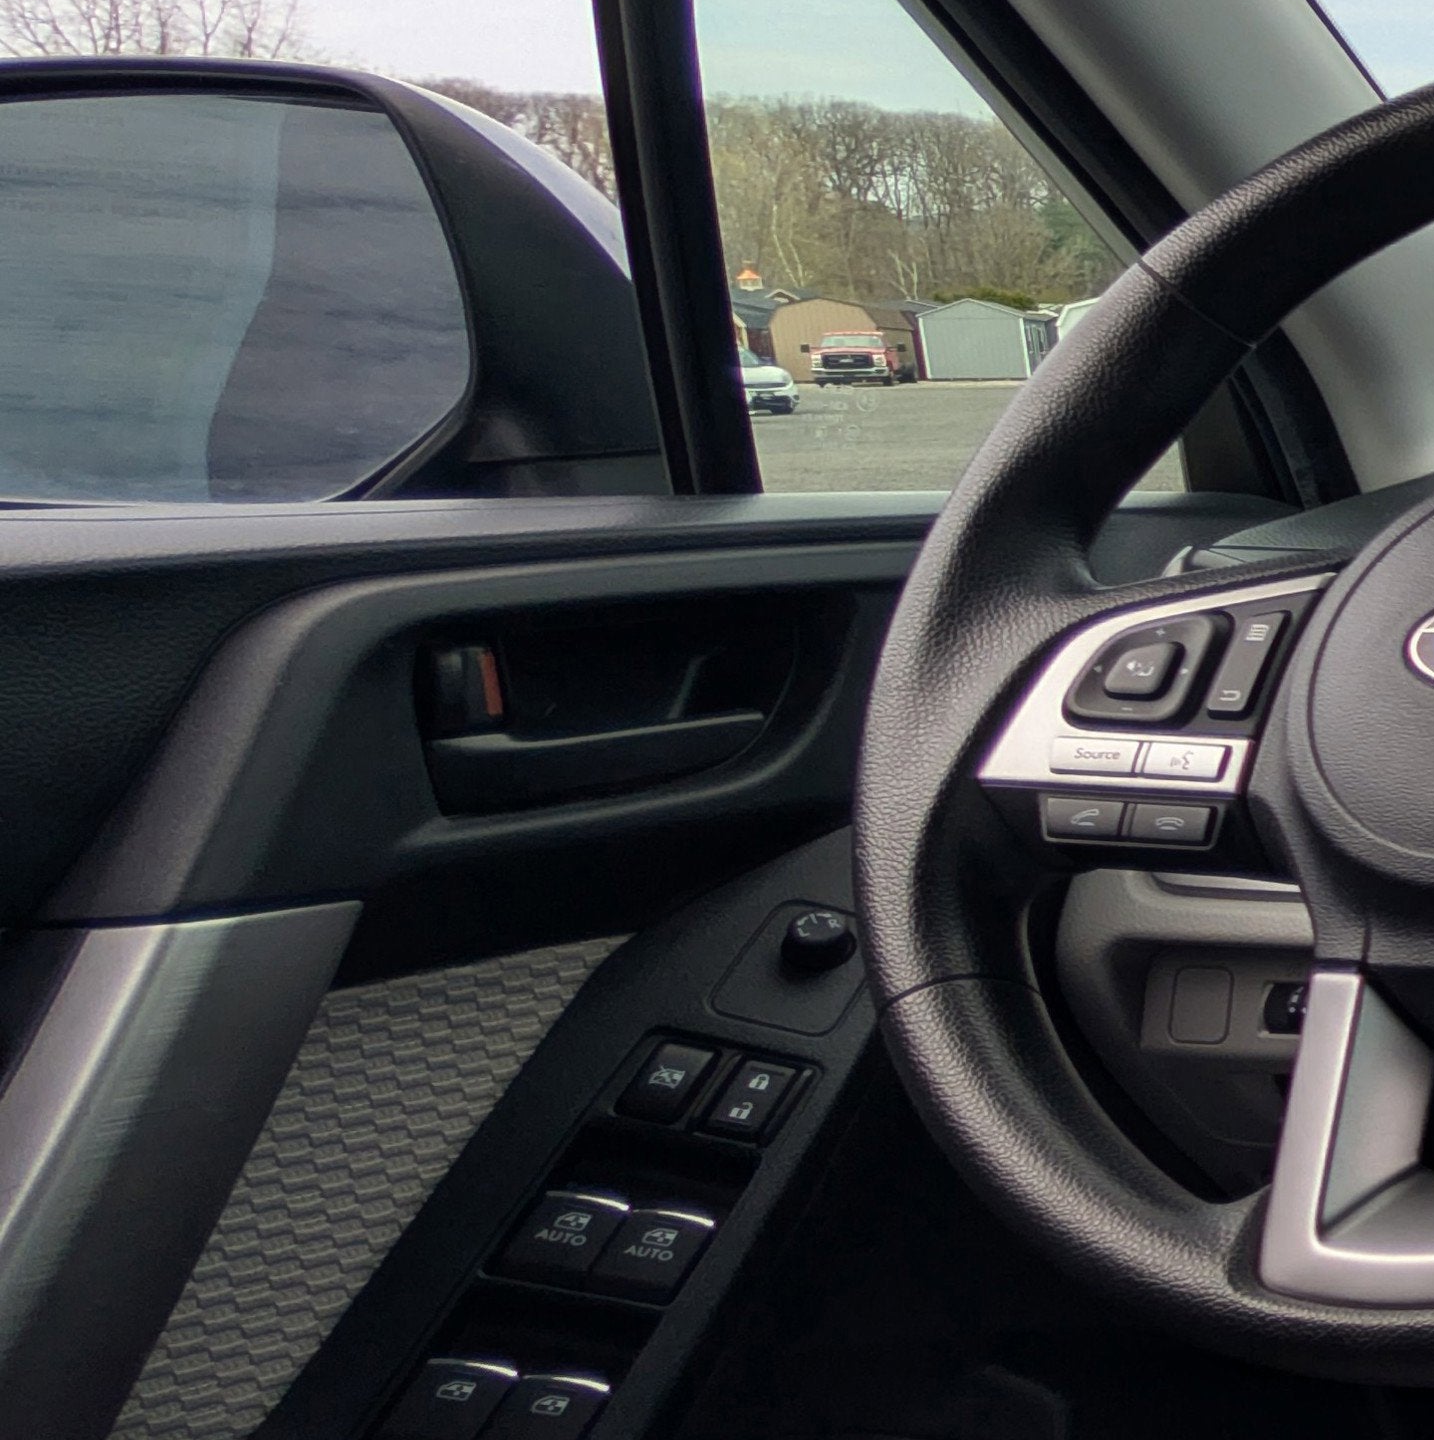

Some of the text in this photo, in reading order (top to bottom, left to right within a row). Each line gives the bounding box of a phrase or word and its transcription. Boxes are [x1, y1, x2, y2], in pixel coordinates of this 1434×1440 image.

[1074, 747, 1120, 760] Source
[534, 1228, 588, 1247] AUTO
[623, 1244, 674, 1262] AUTO
